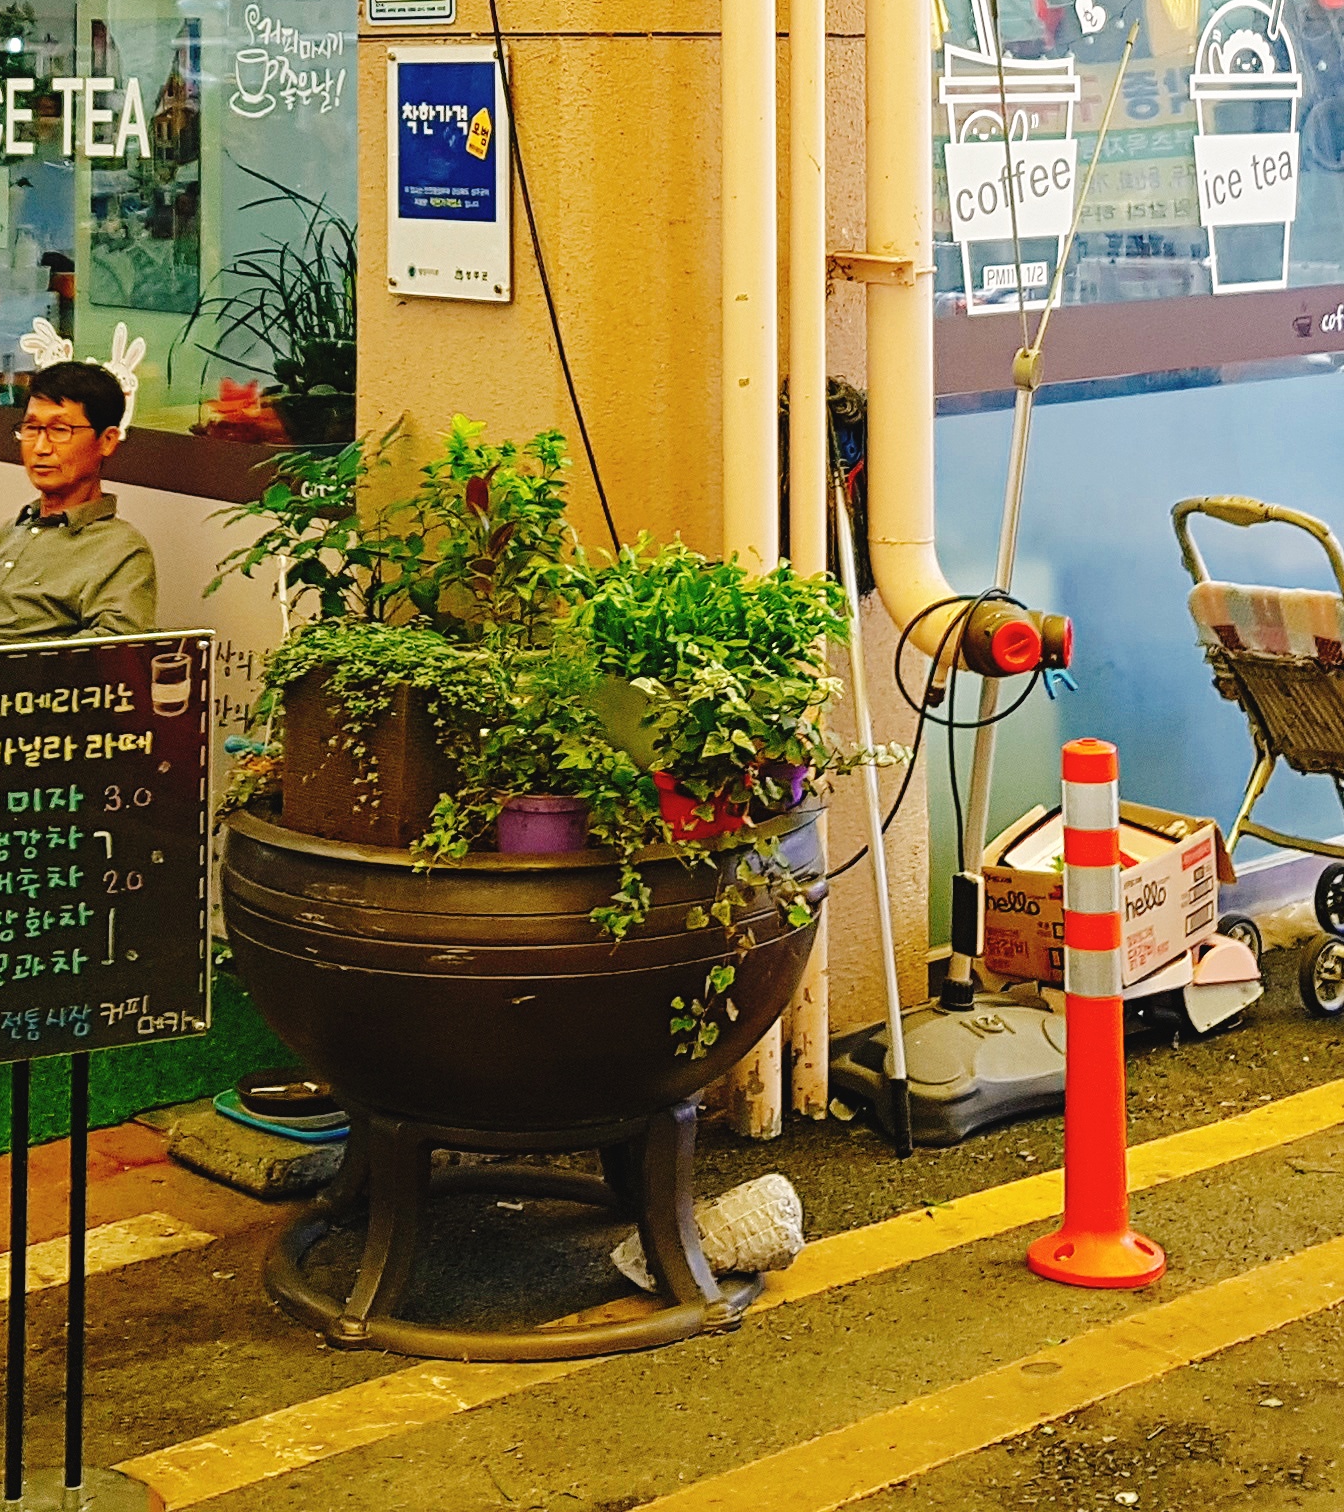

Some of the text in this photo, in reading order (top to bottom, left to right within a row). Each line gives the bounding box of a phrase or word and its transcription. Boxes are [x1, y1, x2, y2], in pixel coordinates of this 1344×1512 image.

[52, 76, 152, 159] TEA
[402, 102, 469, 136] 착한가격
[955, 157, 1072, 222] coffee
[1204, 168, 1243, 210] ice
[1250, 150, 1292, 192] tea
[86, 730, 154, 761] 라떼
[103, 784, 153, 814] 3.0
[102, 870, 145, 895] 2.0
[985, 890, 1040, 916] hello
[1124, 880, 1166, 922] hello
